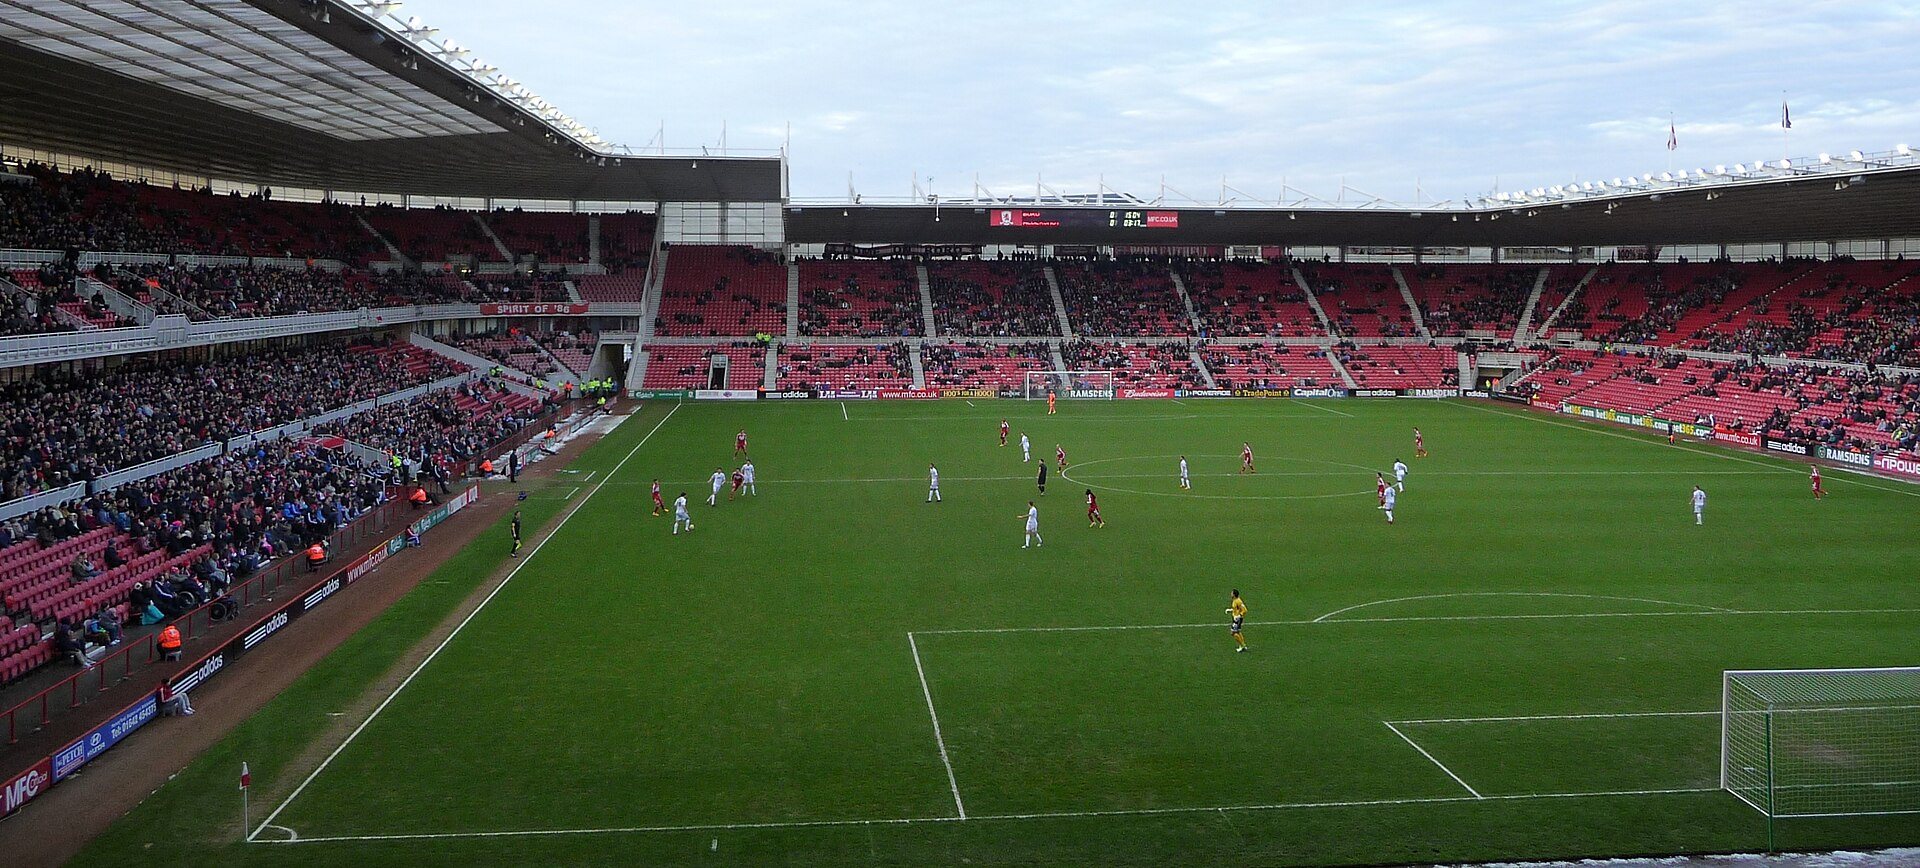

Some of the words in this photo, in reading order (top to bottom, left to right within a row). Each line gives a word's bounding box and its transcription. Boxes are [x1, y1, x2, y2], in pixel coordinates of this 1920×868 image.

[1147, 216, 1178, 224] MFC.CO.UK
[497, 304, 530, 314] SPIRIT
[534, 304, 549, 313] OF
[553, 304, 570, 313] '86
[782, 391, 809, 399] adidas
[881, 390, 938, 398] www.mfc.co.uk
[1070, 390, 1114, 398] RAMSDENS
[1123, 389, 1169, 398] Budweiser
[1242, 389, 1282, 397] TradePoint
[1415, 389, 1458, 397] RAMSDENS
[1466, 390, 1489, 398] adidas
[1562, 403, 1595, 418] bet365.com
[1596, 407, 1631, 424] bet365.com
[1631, 414, 1668, 431] bet365.com
[1714, 431, 1758, 446] www.mfc.co.uk
[1781, 442, 1807, 455] adidas
[1826, 448, 1870, 465] RAMSDENS
[347, 544, 389, 583] www.mfc.co.uk
[322, 577, 340, 598] adidas
[266, 611, 288, 634] adidas
[198, 653, 223, 681] adidas
[5, 769, 39, 812] MFC
